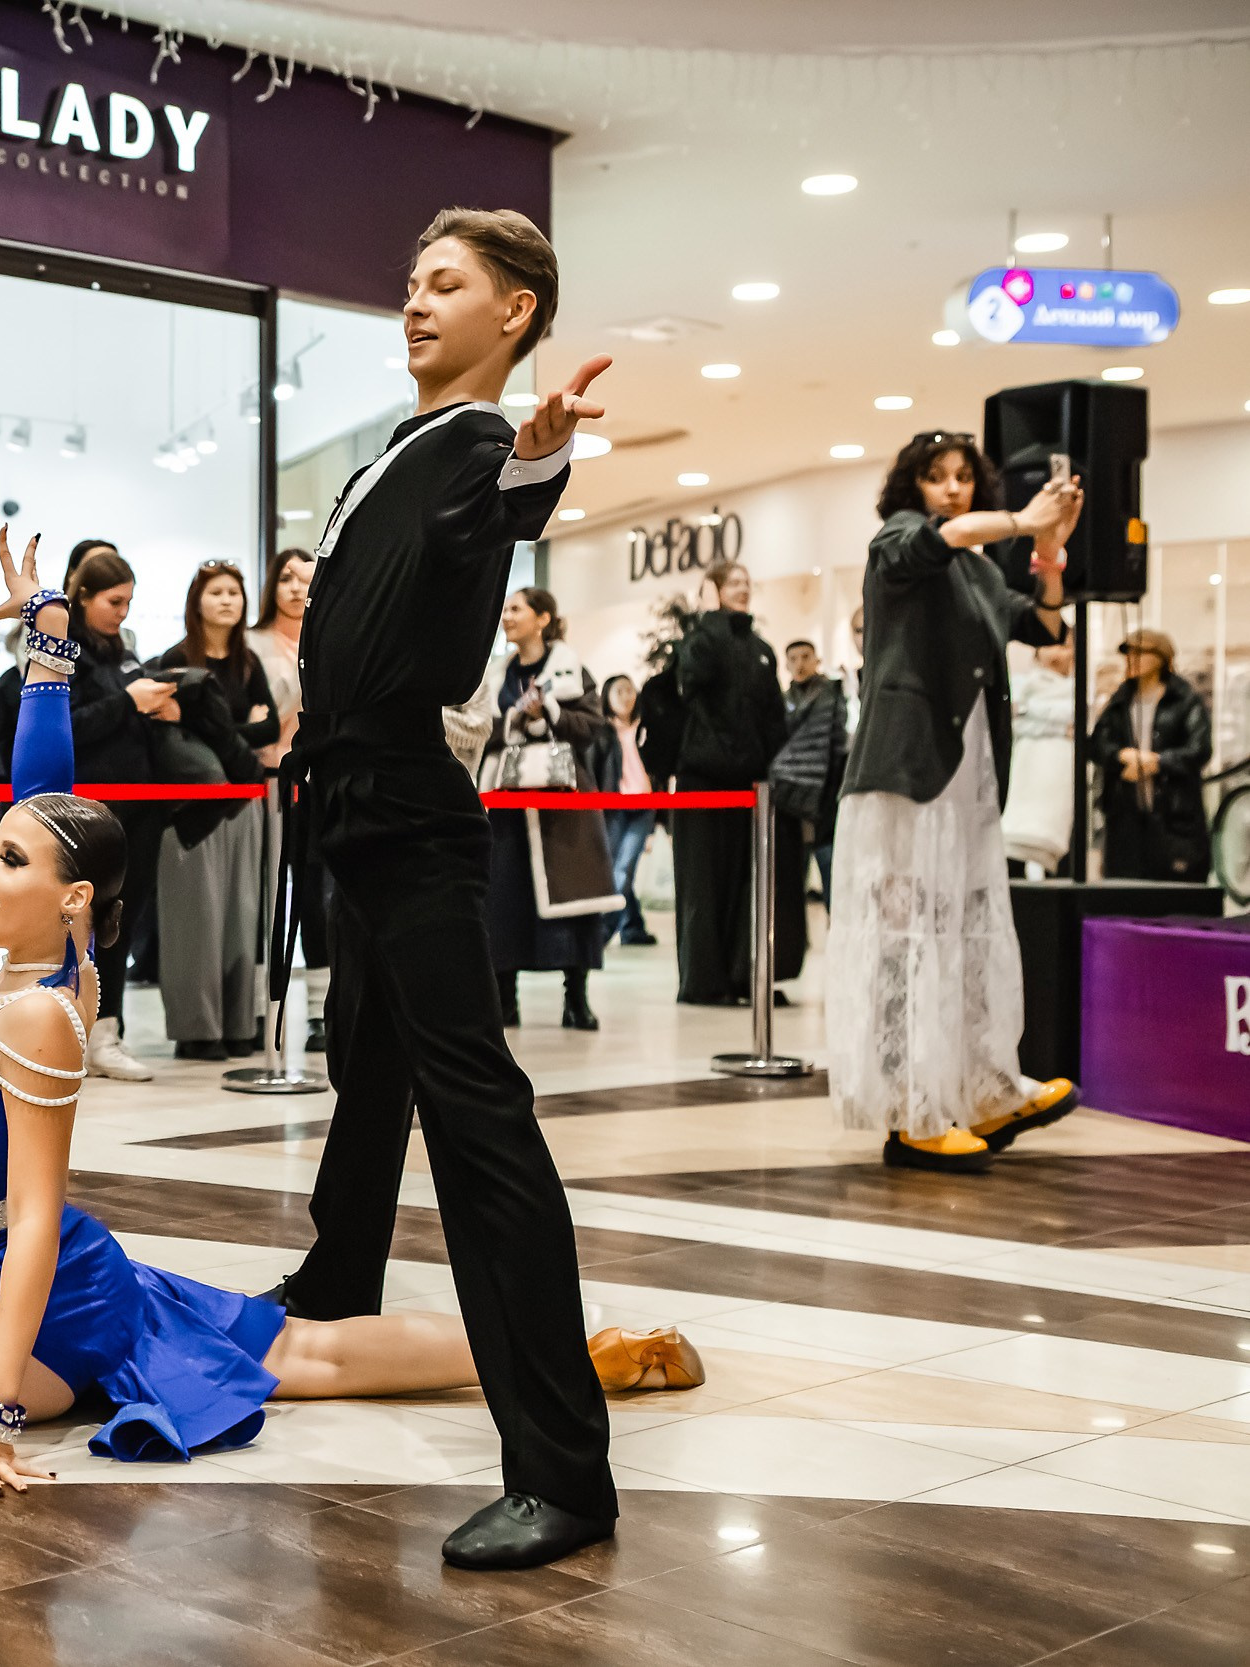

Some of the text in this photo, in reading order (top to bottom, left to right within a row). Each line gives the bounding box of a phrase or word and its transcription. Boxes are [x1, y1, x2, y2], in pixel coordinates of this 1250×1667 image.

[1, 66, 211, 173] LADY
[1031, 302, 1161, 333] Детский мир
